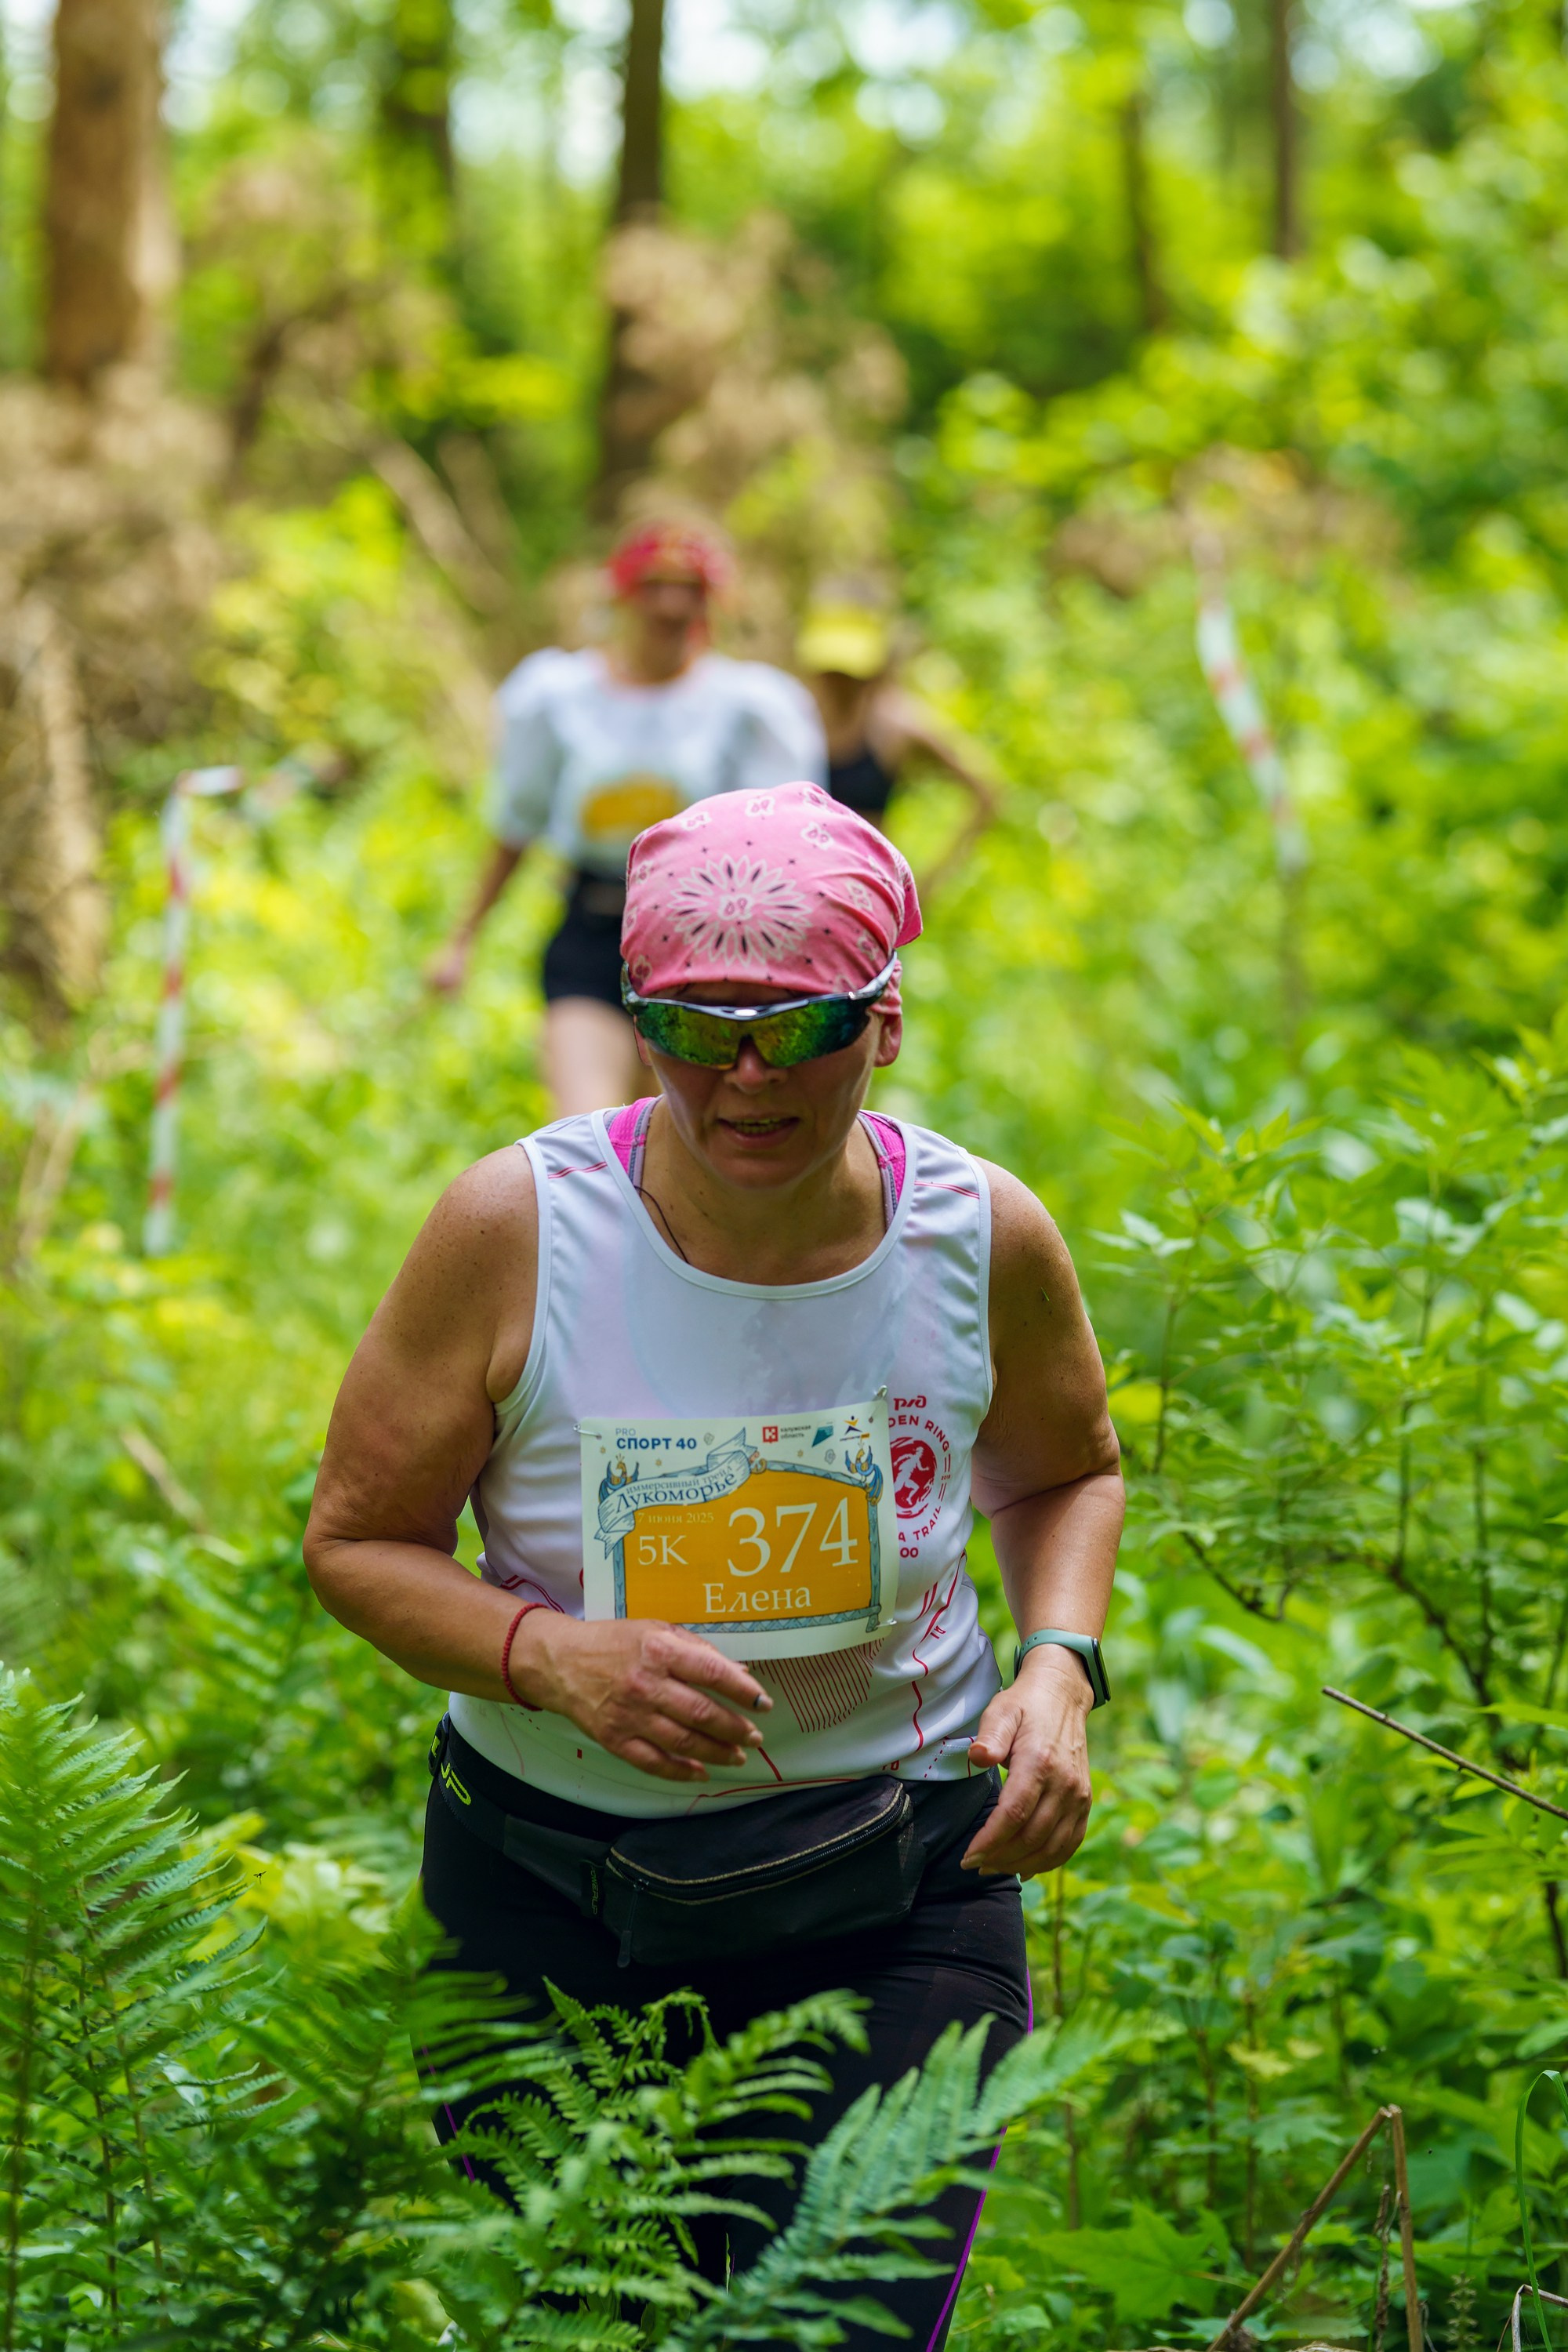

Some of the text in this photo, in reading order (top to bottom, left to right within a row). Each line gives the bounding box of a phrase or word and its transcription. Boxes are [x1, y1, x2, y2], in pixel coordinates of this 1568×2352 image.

[615, 1428, 636, 1436] PRO
[616, 1438, 697, 1450] СПОРТ 40
[888, 1414, 950, 1452] DEN RING
[615, 1473, 738, 1514] Лукоморье
[638, 1512, 714, 1523] 7 июня 2025
[913, 1505, 942, 1541] TRAIL
[728, 1497, 858, 1577] 374
[702, 1582, 812, 1613] Елена
